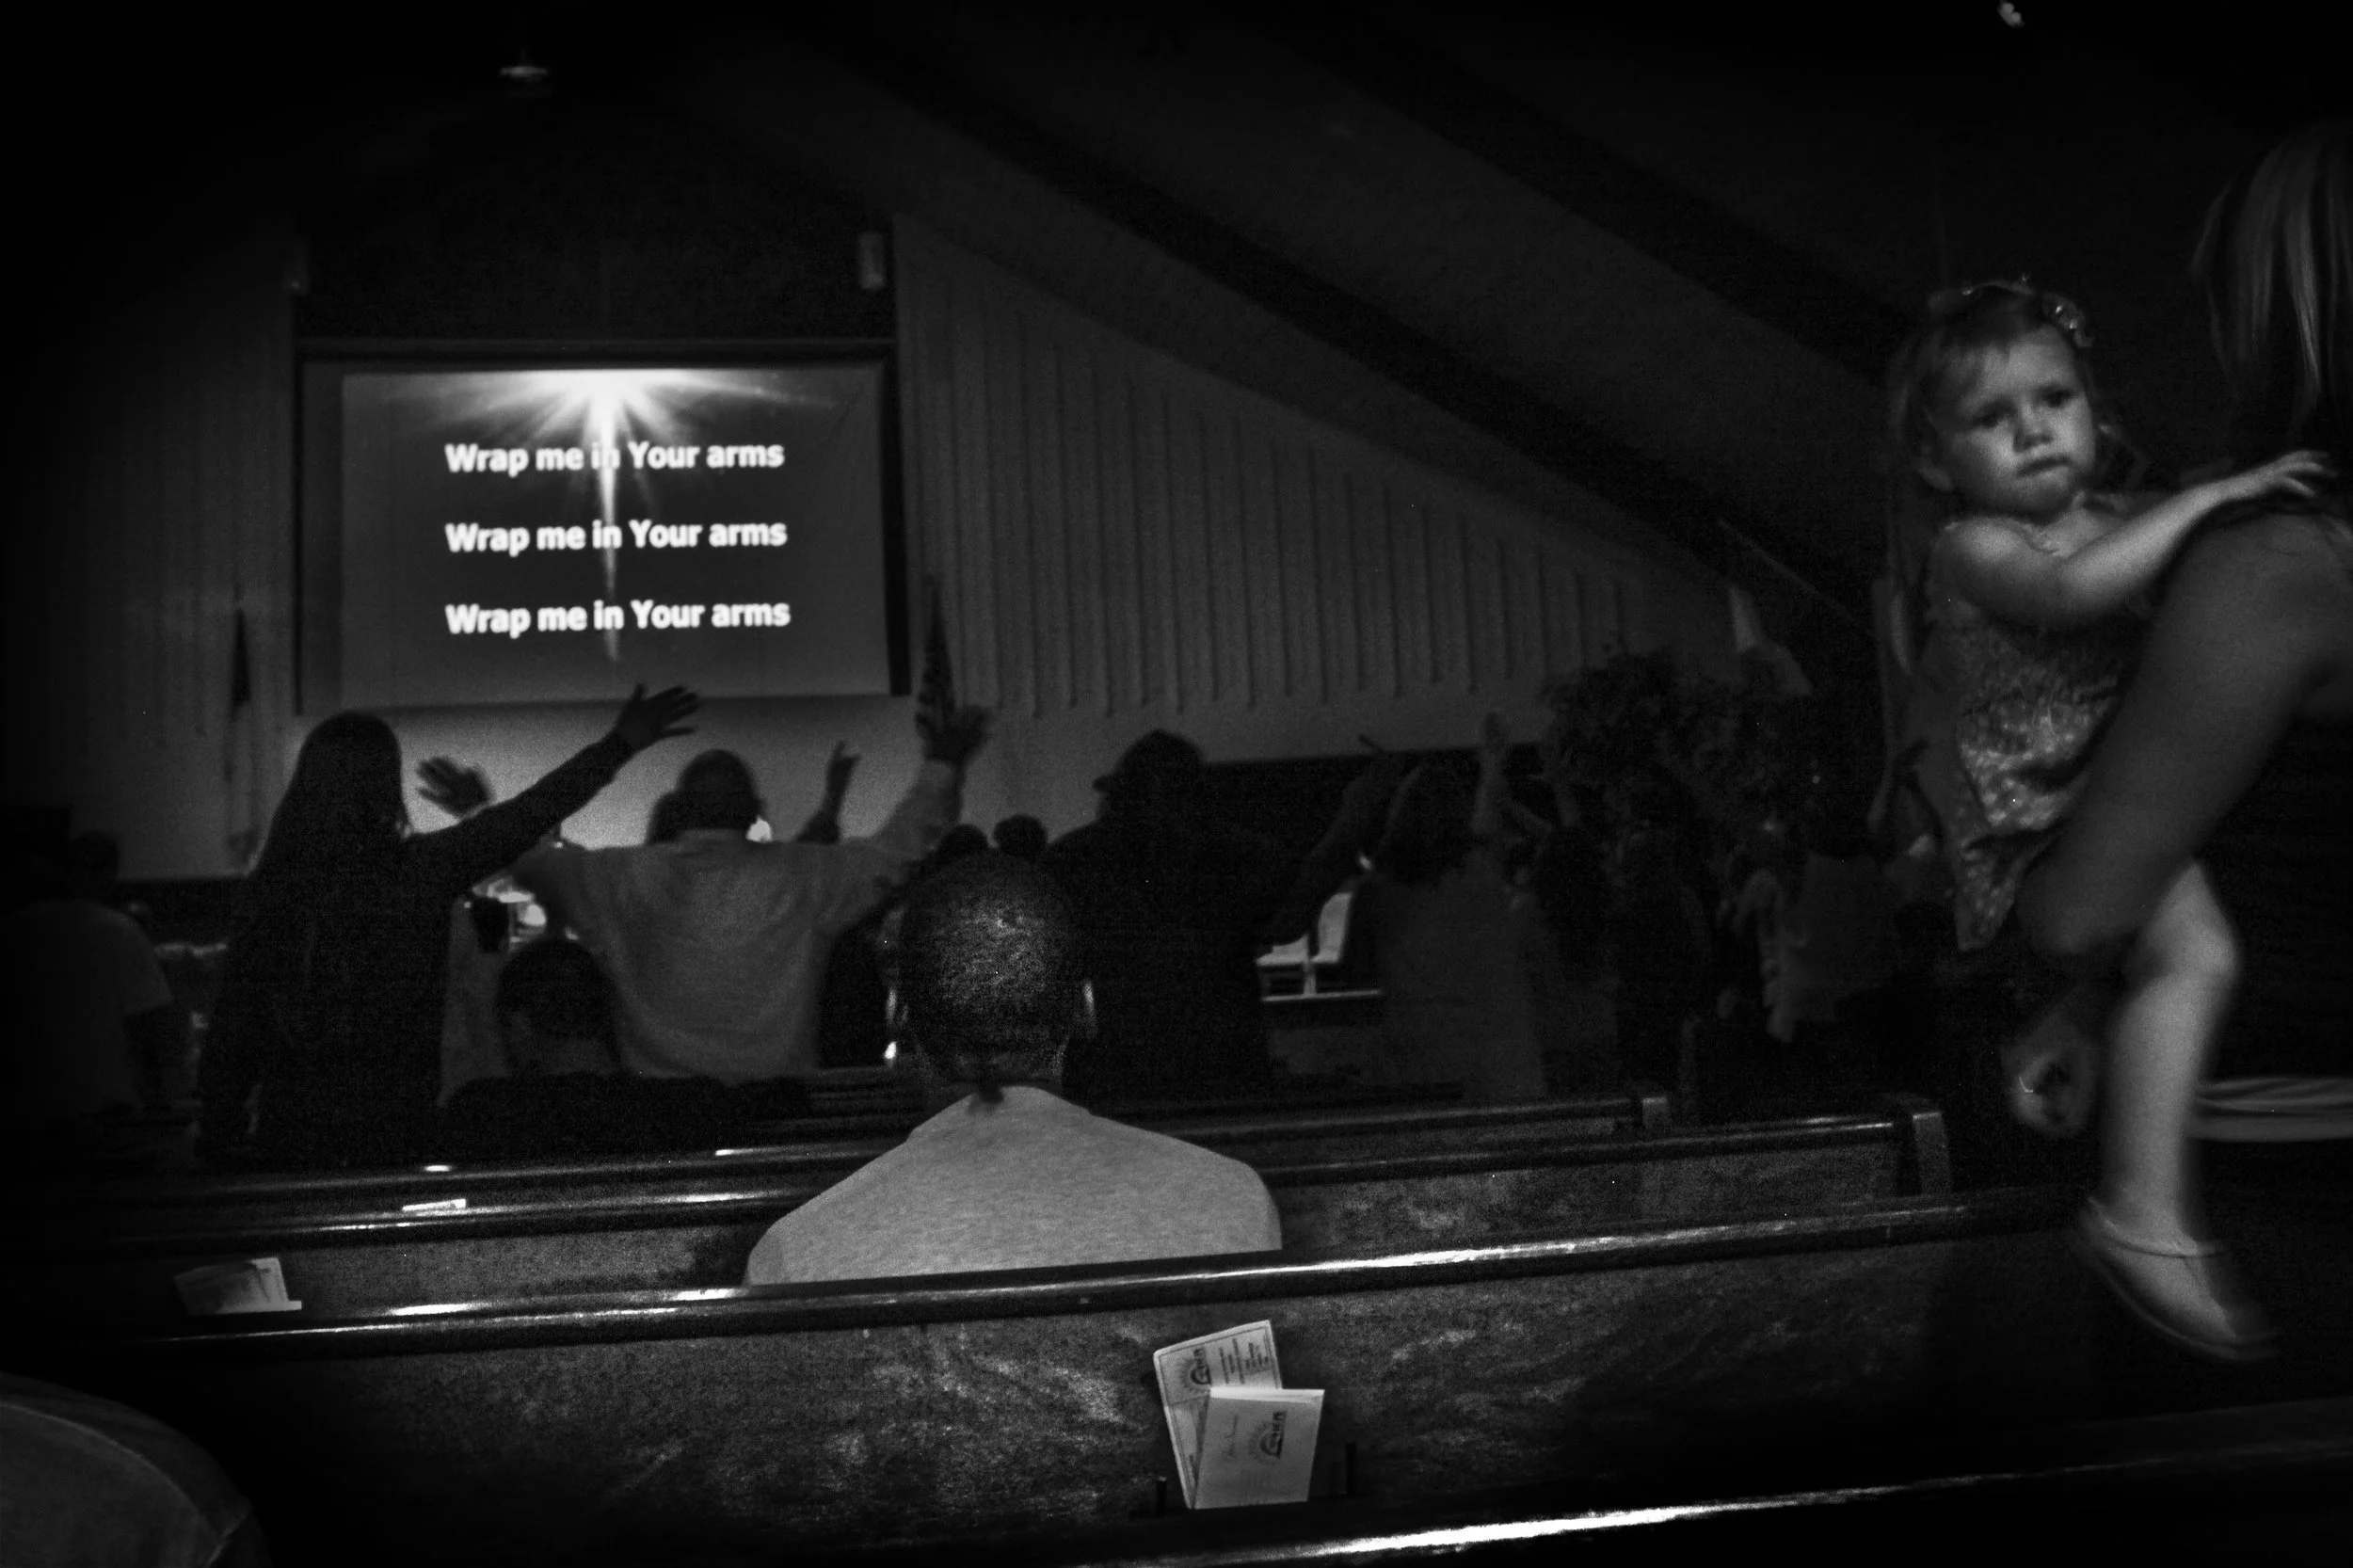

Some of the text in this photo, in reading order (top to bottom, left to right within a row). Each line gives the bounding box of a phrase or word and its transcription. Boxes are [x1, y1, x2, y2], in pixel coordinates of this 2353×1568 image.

[445, 441, 785, 477] Wrap me in Your arms
[445, 519, 788, 557] Wrap me in Your arms
[445, 600, 791, 638] Wrap me in Your arms
